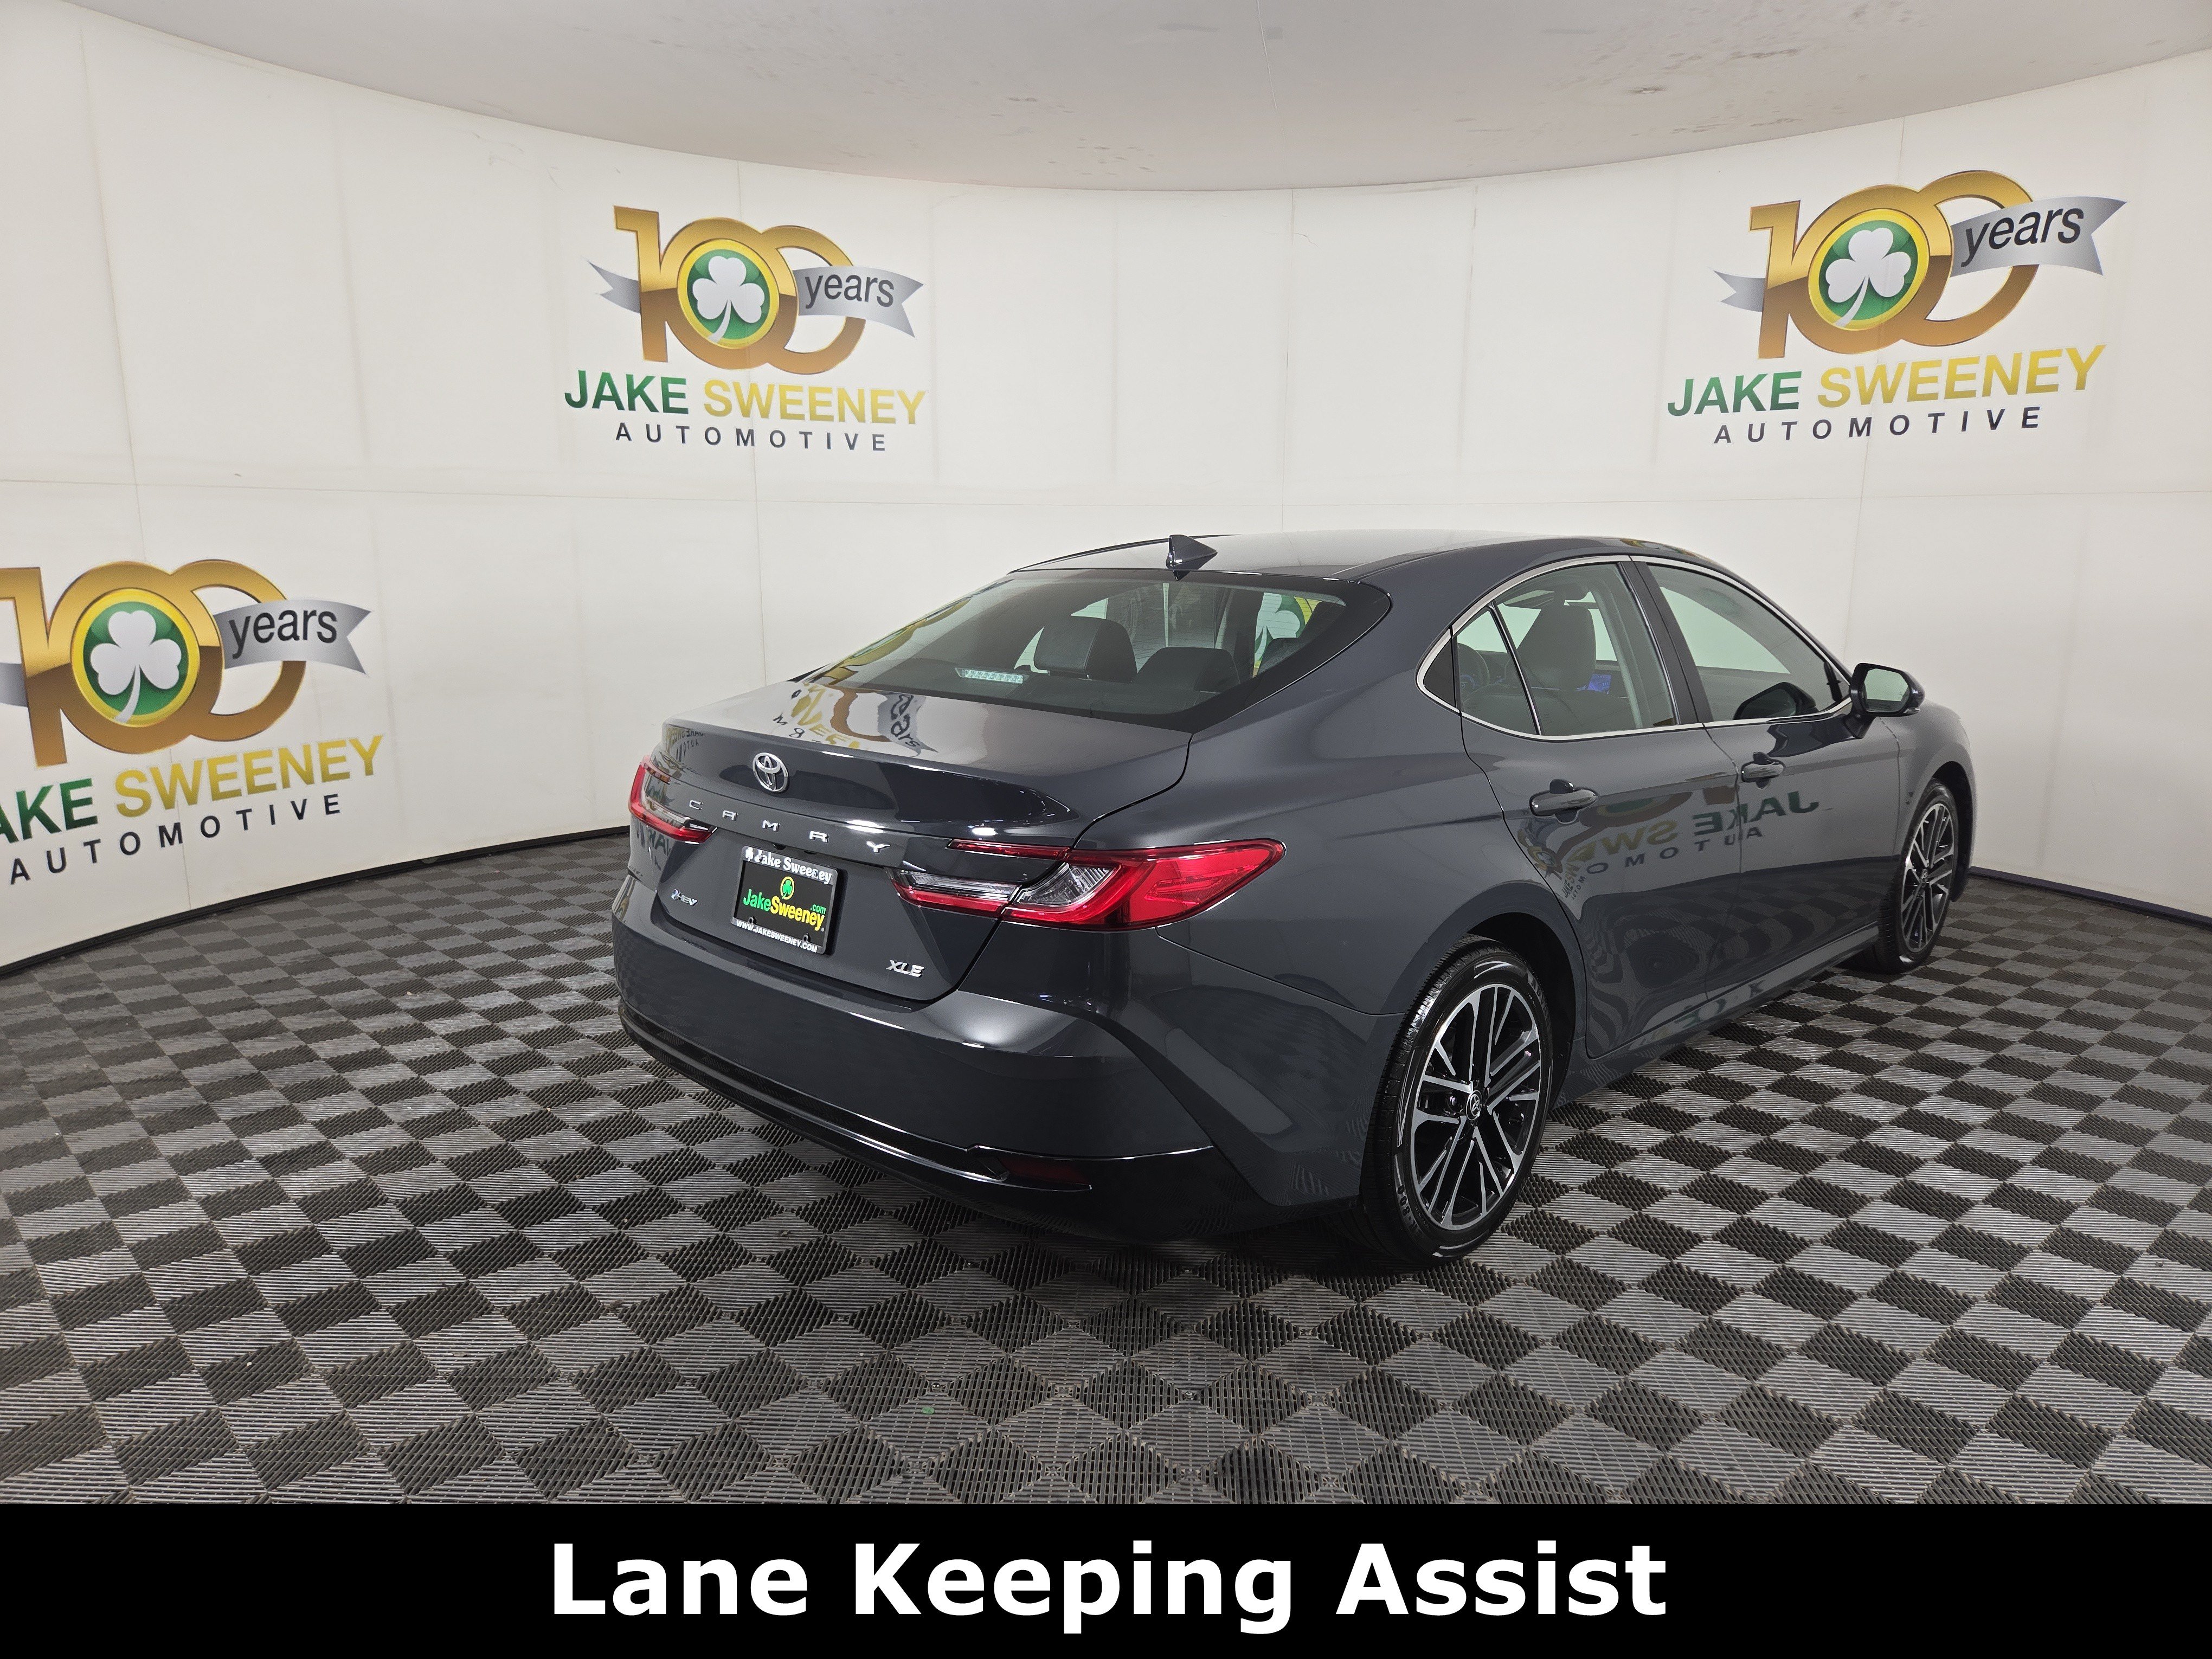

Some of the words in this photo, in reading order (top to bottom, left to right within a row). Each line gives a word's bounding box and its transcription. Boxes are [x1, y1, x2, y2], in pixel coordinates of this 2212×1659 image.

[614, 205, 866, 375] 100
[805, 272, 895, 309] years
[1749, 170, 2040, 359] 100
[1960, 207, 2085, 268] years
[564, 369, 690, 415] JAKE
[703, 378, 927, 425] SWEENEY
[1667, 371, 1802, 416] JAKE
[1817, 344, 2107, 408] SWEENEY
[615, 422, 886, 452] AUTOMOTIVE
[1713, 406, 2041, 445] AUTOMOTIVE
[228, 608, 338, 660] years
[114, 735, 383, 818] SWEENEY
[10, 793, 340, 885] AUTOMOTIVE
[689, 799, 891, 853] CAMRY
[754, 849, 782, 868] Jake
[783, 857, 832, 885] Sweeney
[736, 919, 818, 953] WWW.JAKESWEENEY.COM
[743, 889, 825, 931] JakeSweeney
[885, 959, 925, 978] XLE
